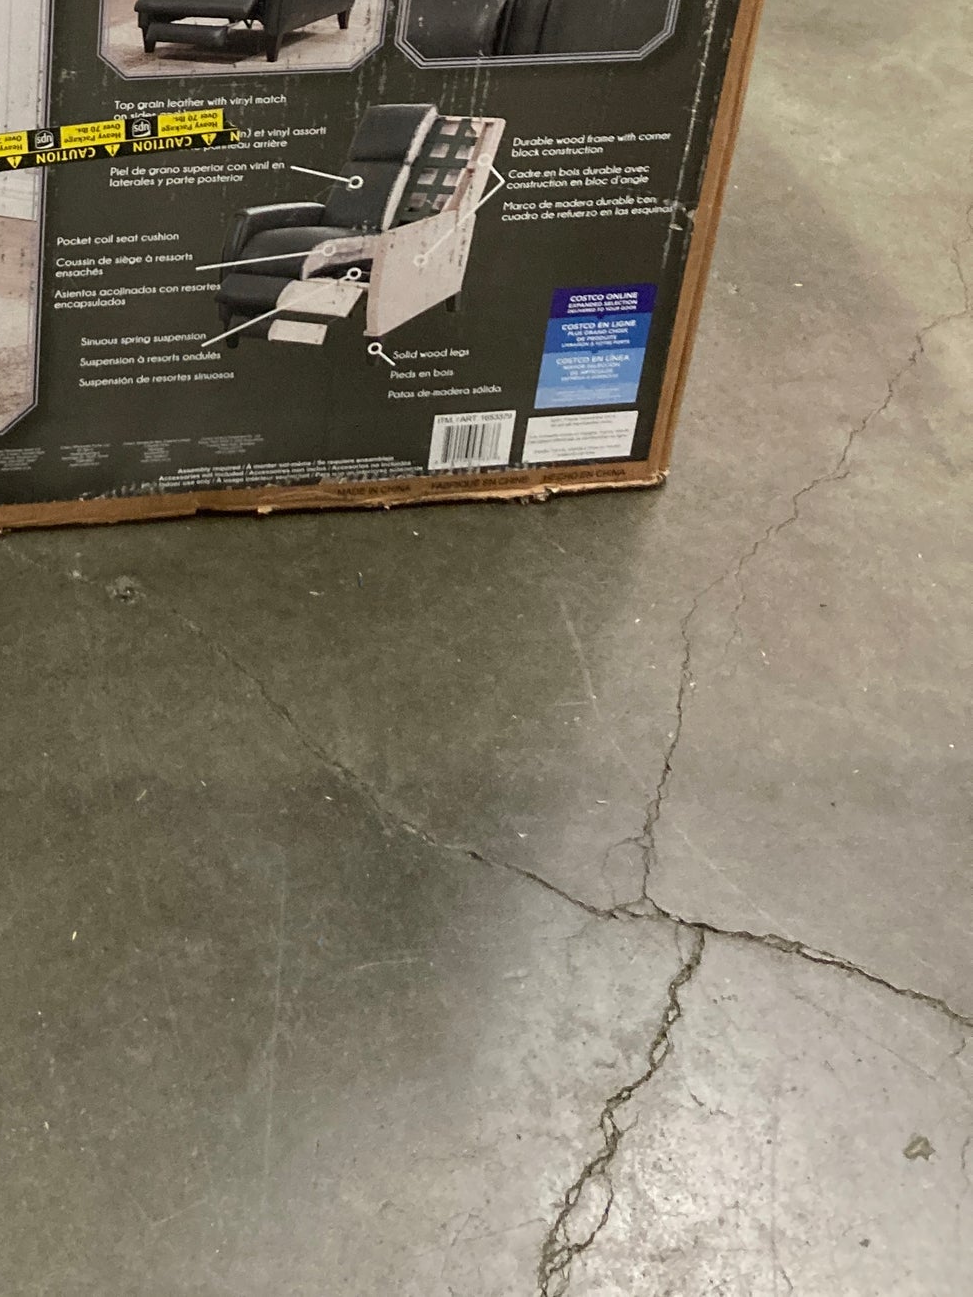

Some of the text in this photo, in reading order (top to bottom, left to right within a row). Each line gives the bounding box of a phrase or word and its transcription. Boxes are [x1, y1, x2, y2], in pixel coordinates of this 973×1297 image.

[114, 94, 287, 111] Top grain leather with vinyl match
[253, 126, 327, 140] et vinyl assorti
[512, 131, 671, 147] Durable wood frame with corner
[252, 139, 289, 149] arrière
[511, 145, 604, 158] block construction
[110, 160, 285, 177] Piel de grano superior con vinil en
[109, 175, 156, 187] laterales
[166, 176, 192, 187] parte
[192, 173, 244, 185] posterior
[56, 232, 180, 247] Pocket coil seat cushion
[56, 256, 96, 268] Coussin
[98, 255, 113, 265] de
[114, 253, 143, 266] siège
[155, 252, 194, 262] ressorts
[55, 267, 104, 278] ensachés
[570, 291, 639, 303] COSTCO ONLINE
[81, 332, 207, 347] Sinuous spring suspension
[392, 347, 470, 361] Solid wood legs
[390, 368, 454, 380] Pieds en bois
[387, 389, 415, 399] Patas
[432, 386, 470, 397] madera
[472, 384, 502, 395] sólida
